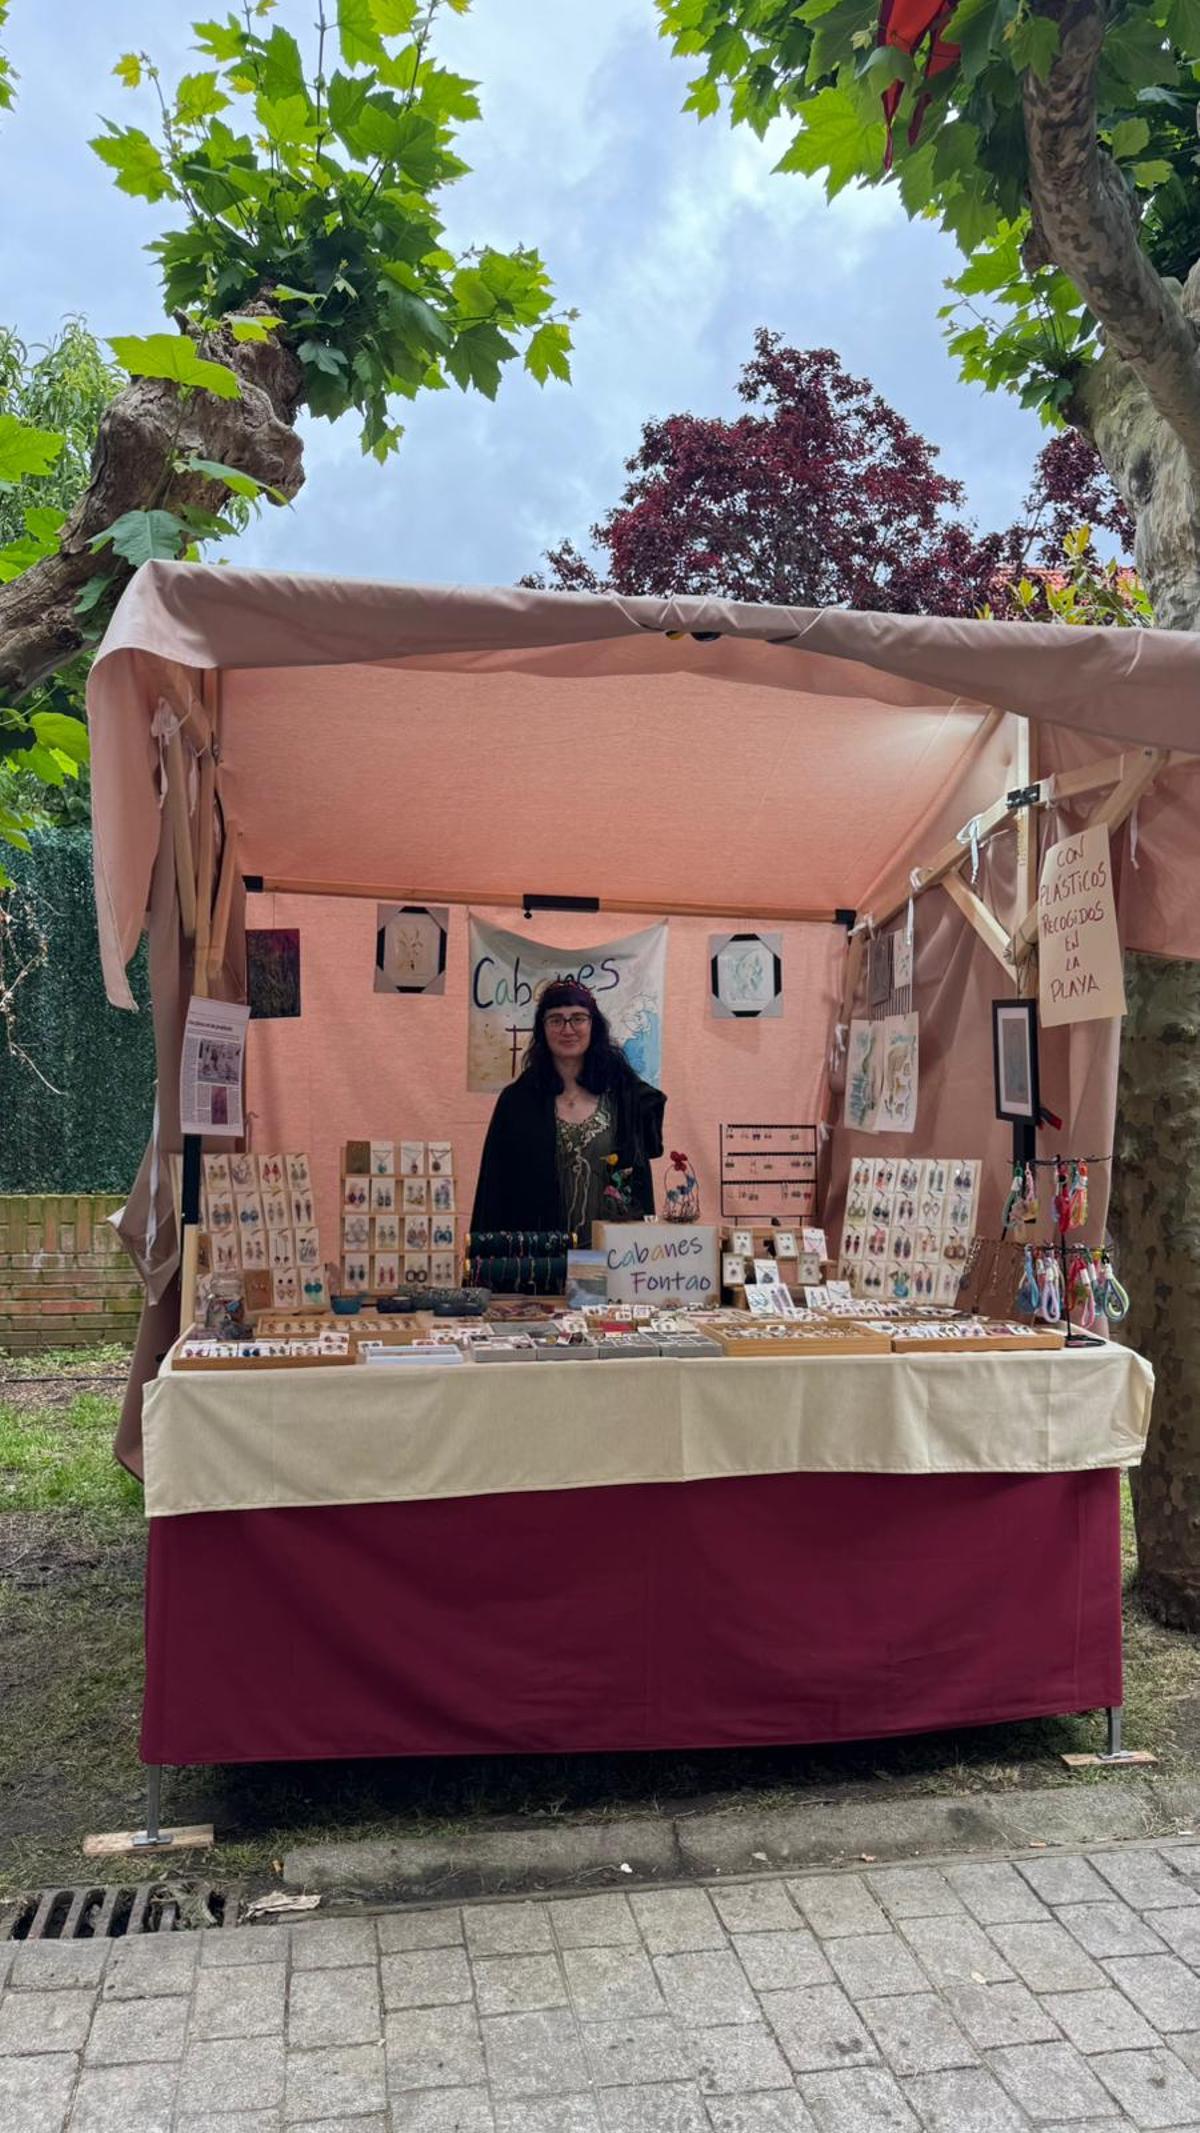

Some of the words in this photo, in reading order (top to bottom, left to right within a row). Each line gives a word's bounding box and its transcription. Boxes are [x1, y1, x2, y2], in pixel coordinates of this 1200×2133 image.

[1057, 835, 1084, 867] CON
[1065, 930, 1079, 952] EN
[1066, 956, 1080, 972] LA
[1051, 973, 1100, 1003] PLAYA
[607, 1237, 703, 1270] Cabanes
[630, 1271, 711, 1295] Fontao
